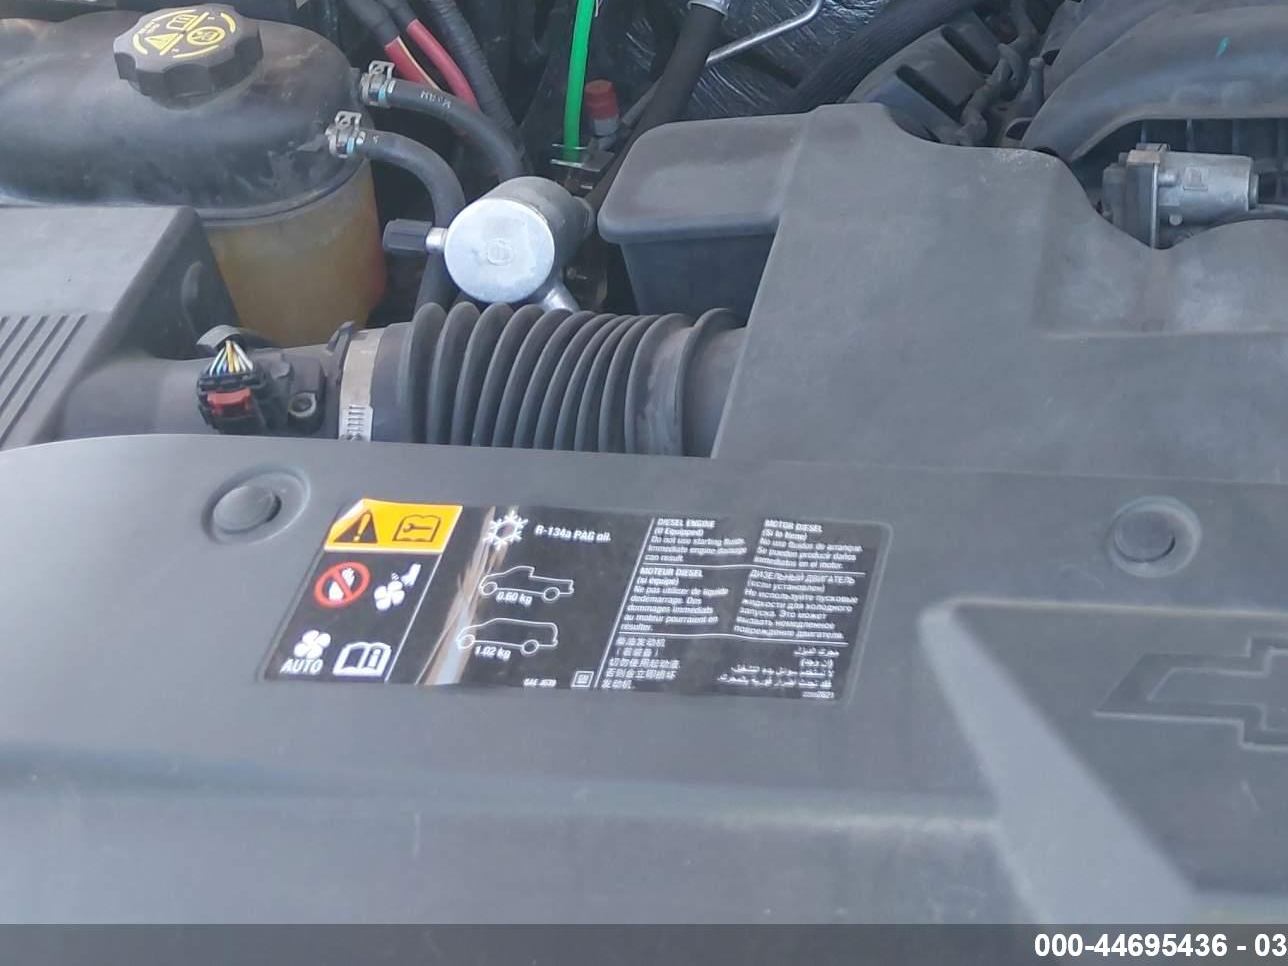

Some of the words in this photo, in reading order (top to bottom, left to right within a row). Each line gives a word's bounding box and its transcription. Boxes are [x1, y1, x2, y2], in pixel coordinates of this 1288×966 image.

[657, 518, 684, 527] DIESEL
[686, 519, 715, 528] ENGINE
[765, 520, 794, 530] MOTOR
[796, 523, 823, 533] DIESEL
[535, 525, 572, 540] R-134a
[574, 532, 595, 542] PAG
[597, 532, 612, 543] oil.
[665, 528, 704, 537] Equipped)
[651, 536, 662, 544] Do
[693, 538, 722, 546] starting
[648, 545, 688, 553] Immediate
[690, 547, 716, 555] engine
[757, 546, 768, 554] Se
[640, 567, 674, 576] MOTEUR
[675, 569, 703, 578] DIESEL
[634, 586, 644, 594] Ne
[497, 592, 519, 603] 0.60
[520, 593, 533, 607] kg
[627, 605, 671, 614] dommages
[475, 645, 498, 657] 1.02
[498, 647, 511, 661] kg
[280, 658, 324, 675] AUTO
